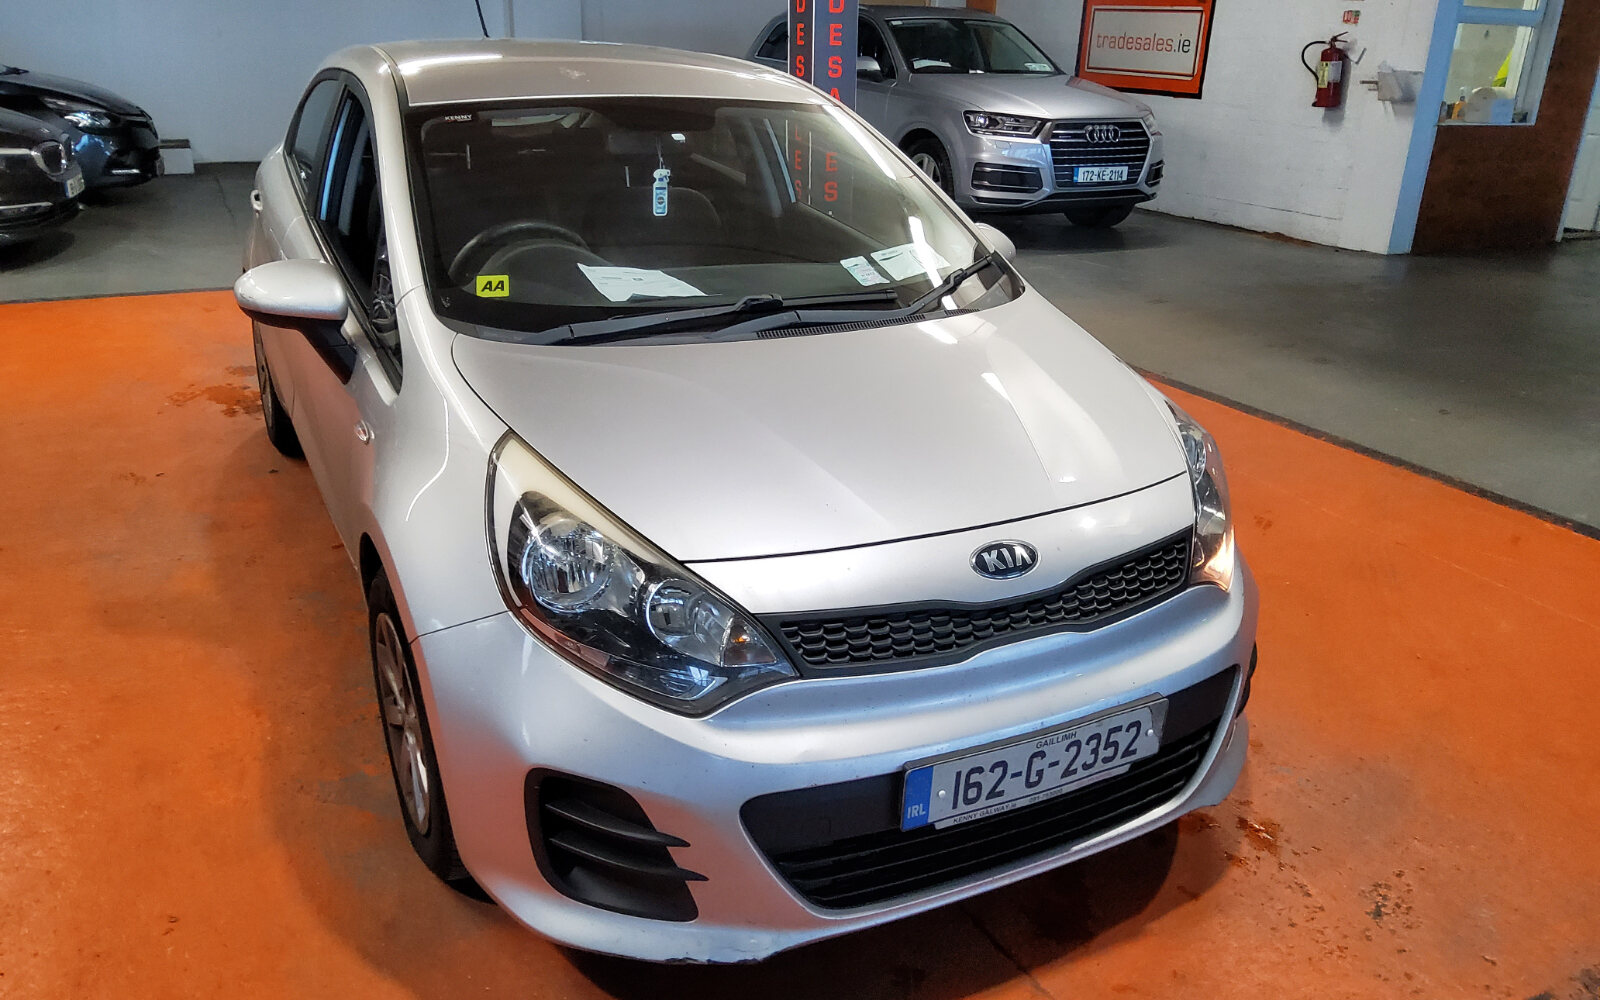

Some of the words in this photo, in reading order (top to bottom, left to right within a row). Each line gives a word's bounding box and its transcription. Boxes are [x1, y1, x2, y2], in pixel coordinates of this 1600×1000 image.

[1096, 32, 1191, 54] tradesales.ie
[1082, 169, 1124, 181] 172-KE-2114
[481, 280, 505, 292] AA
[981, 545, 1033, 572] KIA
[1035, 731, 1077, 749] GAILLIMH
[951, 719, 1143, 810] 162-G-2352
[907, 803, 927, 819] IRL
[953, 811, 978, 824] KENNY
